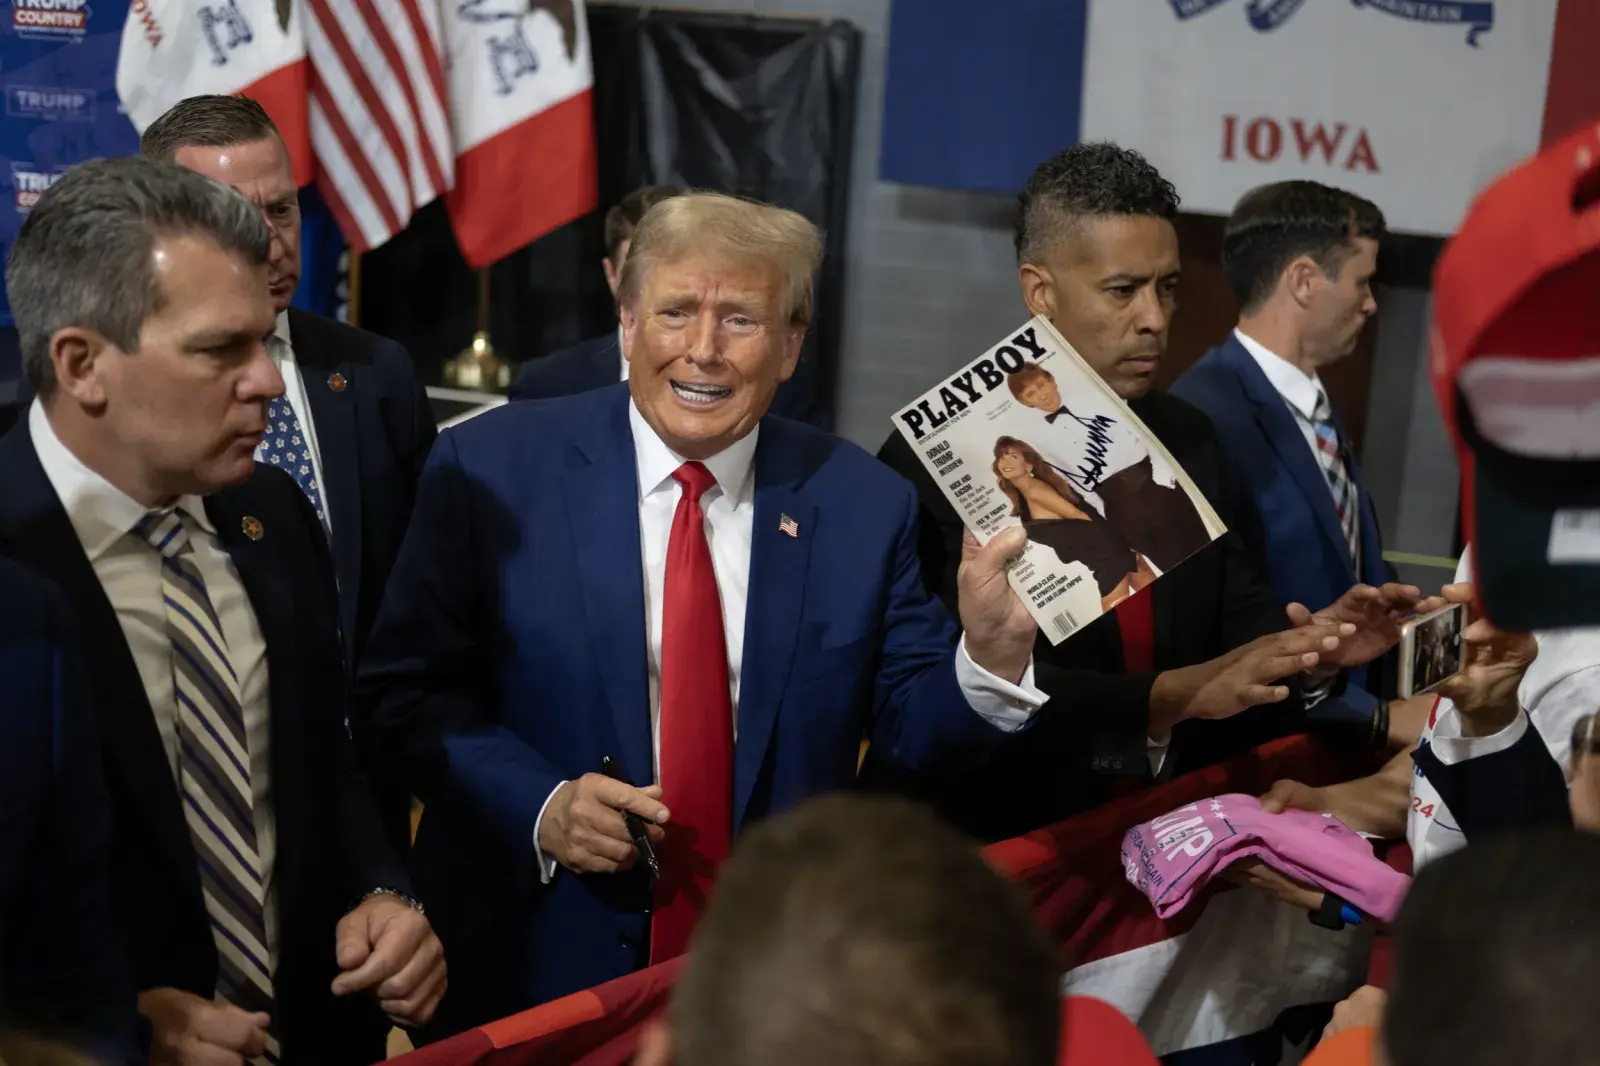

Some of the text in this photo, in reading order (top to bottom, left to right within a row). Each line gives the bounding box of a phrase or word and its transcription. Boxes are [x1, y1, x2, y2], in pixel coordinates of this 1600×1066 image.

[15, 10, 83, 27] COUNTRY
[132, 0, 163, 48] OWA
[17, 90, 86, 109] TRUMP
[1221, 114, 1381, 174] IOWA
[900, 326, 1047, 440] PLAYBOY
[917, 420, 951, 446] ENTERTAINMENT
[925, 440, 951, 460] DONALD
[932, 450, 954, 469] TRUMP
[938, 458, 964, 477] INTERVIEW
[949, 474, 972, 491] ROCK AND
[954, 484, 973, 498] RACISM
[1026, 573, 1057, 596] WORLD-CLASS
[1031, 575, 1069, 603] PLAYMATES FROM
[1036, 600, 1047, 610] OUR
[1065, 575, 1083, 590] EMPIRE
